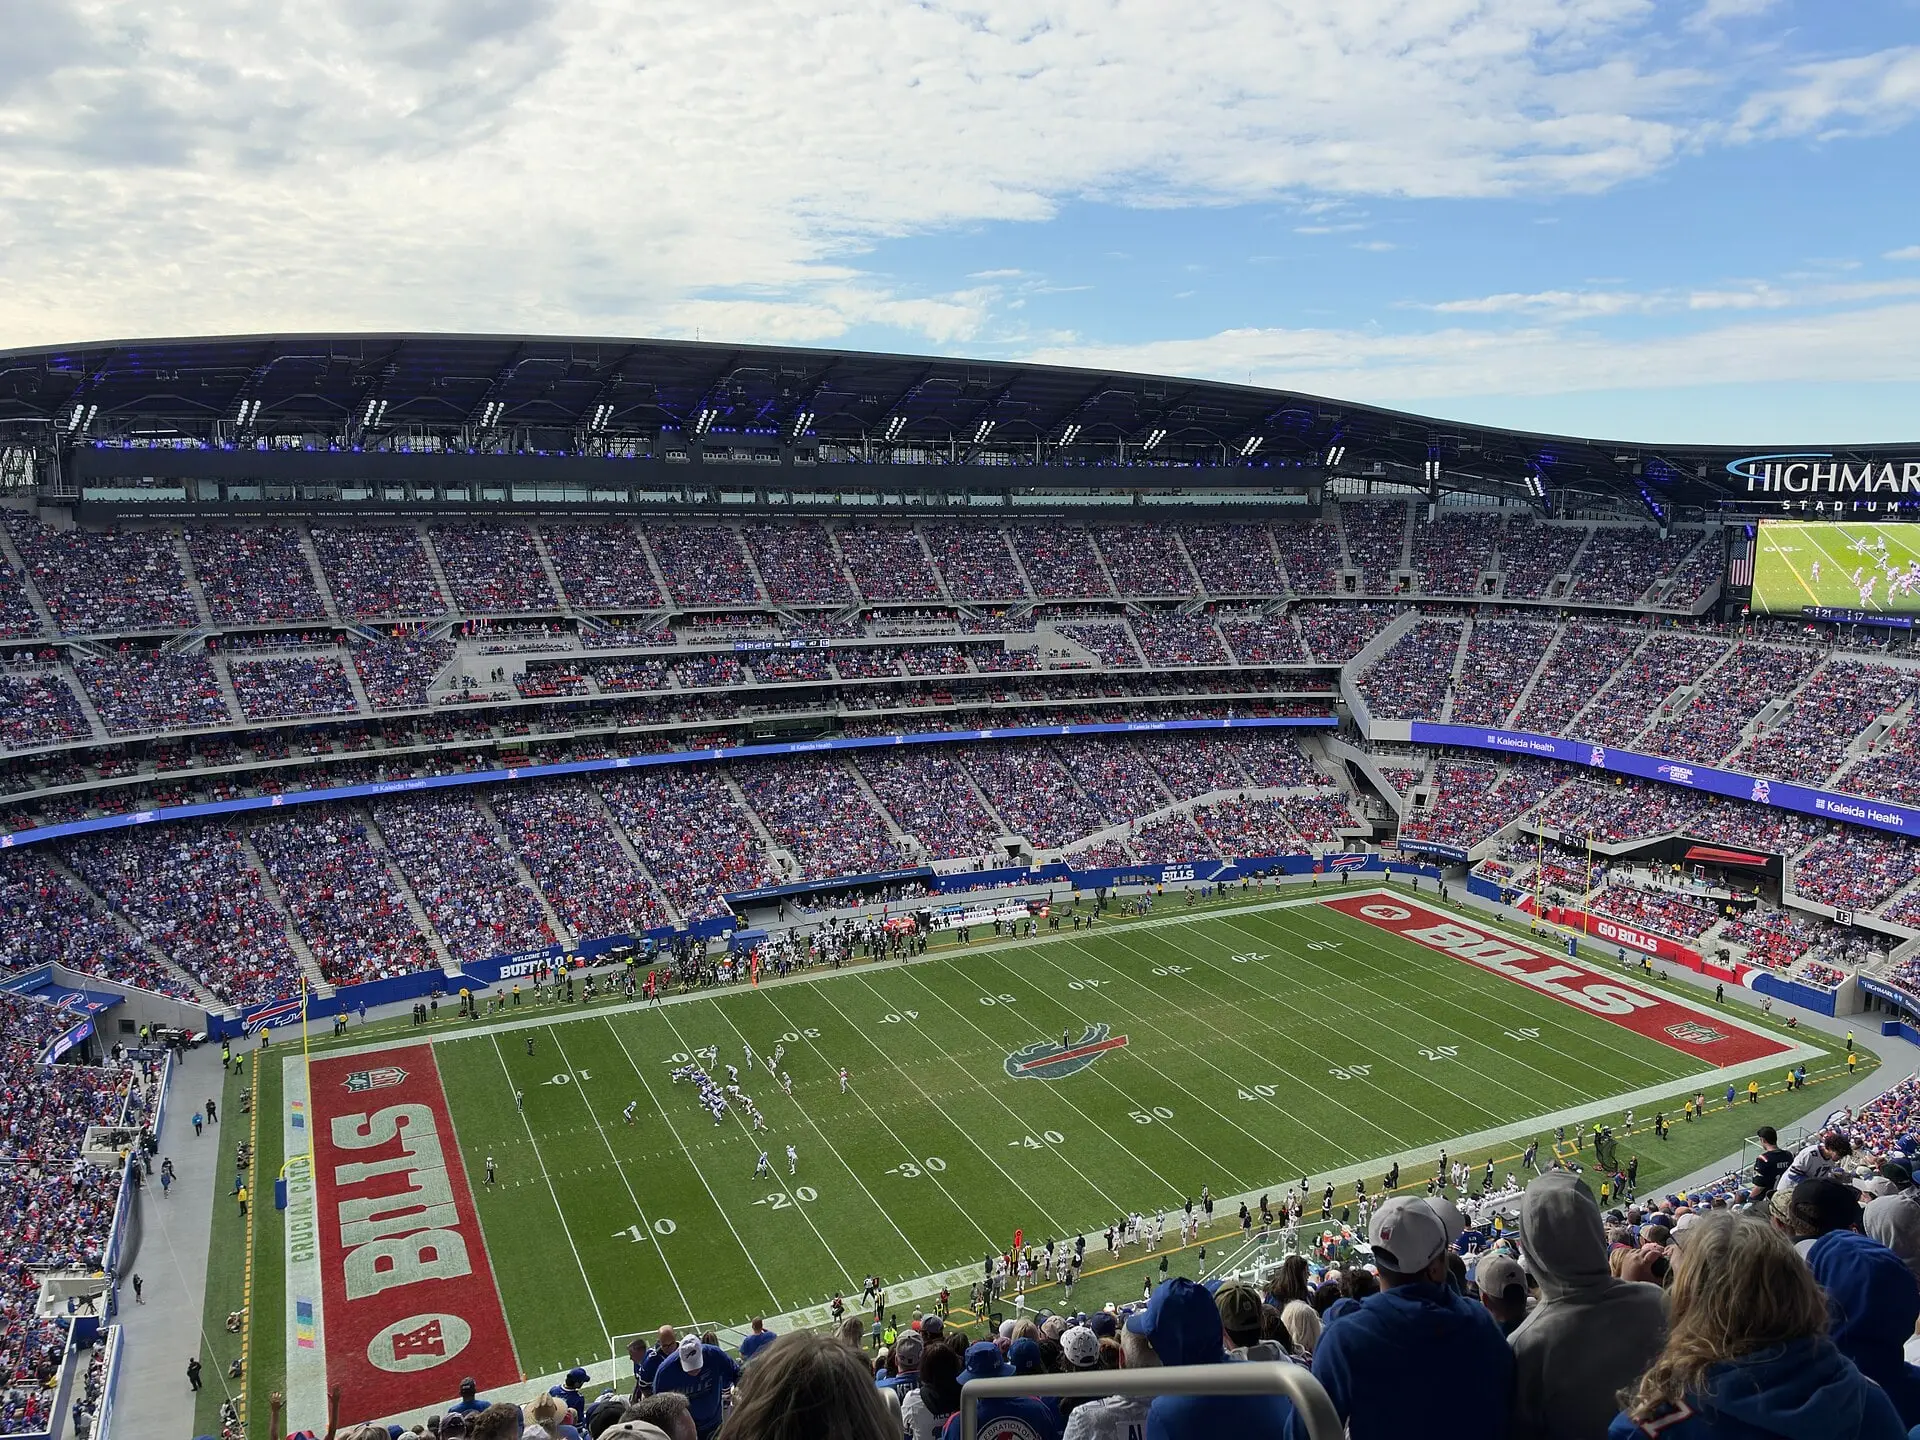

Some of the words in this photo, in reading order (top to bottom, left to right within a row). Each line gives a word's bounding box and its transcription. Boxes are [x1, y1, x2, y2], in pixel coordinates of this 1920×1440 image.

[1782, 500, 1899, 512] STADIUM
[1821, 609, 1832, 618] 21
[1854, 612, 1864, 621] 17
[1497, 736, 1528, 748] Kaleida
[1529, 740, 1555, 752] Health
[380, 782, 403, 792] Kaleida
[405, 780, 427, 789] Health
[1827, 801, 1866, 819] Kaleida
[1867, 809, 1903, 826] Health
[1598, 922, 1617, 938] GO
[1617, 928, 1658, 952] BILLS
[1306, 940, 1337, 951] 10
[512, 953, 541, 963] WELCOME
[1231, 952, 1265, 963] 20
[1151, 965, 1186, 976] 30
[1401, 923, 1661, 1014] BILLS
[1068, 978, 1099, 991] 40
[979, 993, 1017, 1007] 50
[884, 1009, 919, 1024] 40
[783, 1028, 821, 1042] 30
[1504, 1027, 1539, 1042] 10
[1418, 1045, 1458, 1062] 20
[551, 1069, 593, 1085] 10
[1328, 1064, 1370, 1080] 30
[1237, 1084, 1276, 1101] 40
[1127, 1106, 1174, 1125] 50
[1023, 1130, 1065, 1151] 40
[899, 1156, 947, 1178] 30
[331, 1104, 472, 1301] BILLS
[767, 1186, 818, 1210] 20
[291, 1197, 314, 1263] CRUCIAL
[631, 1218, 677, 1243] 10
[1468, 1242, 1478, 1256] 17
